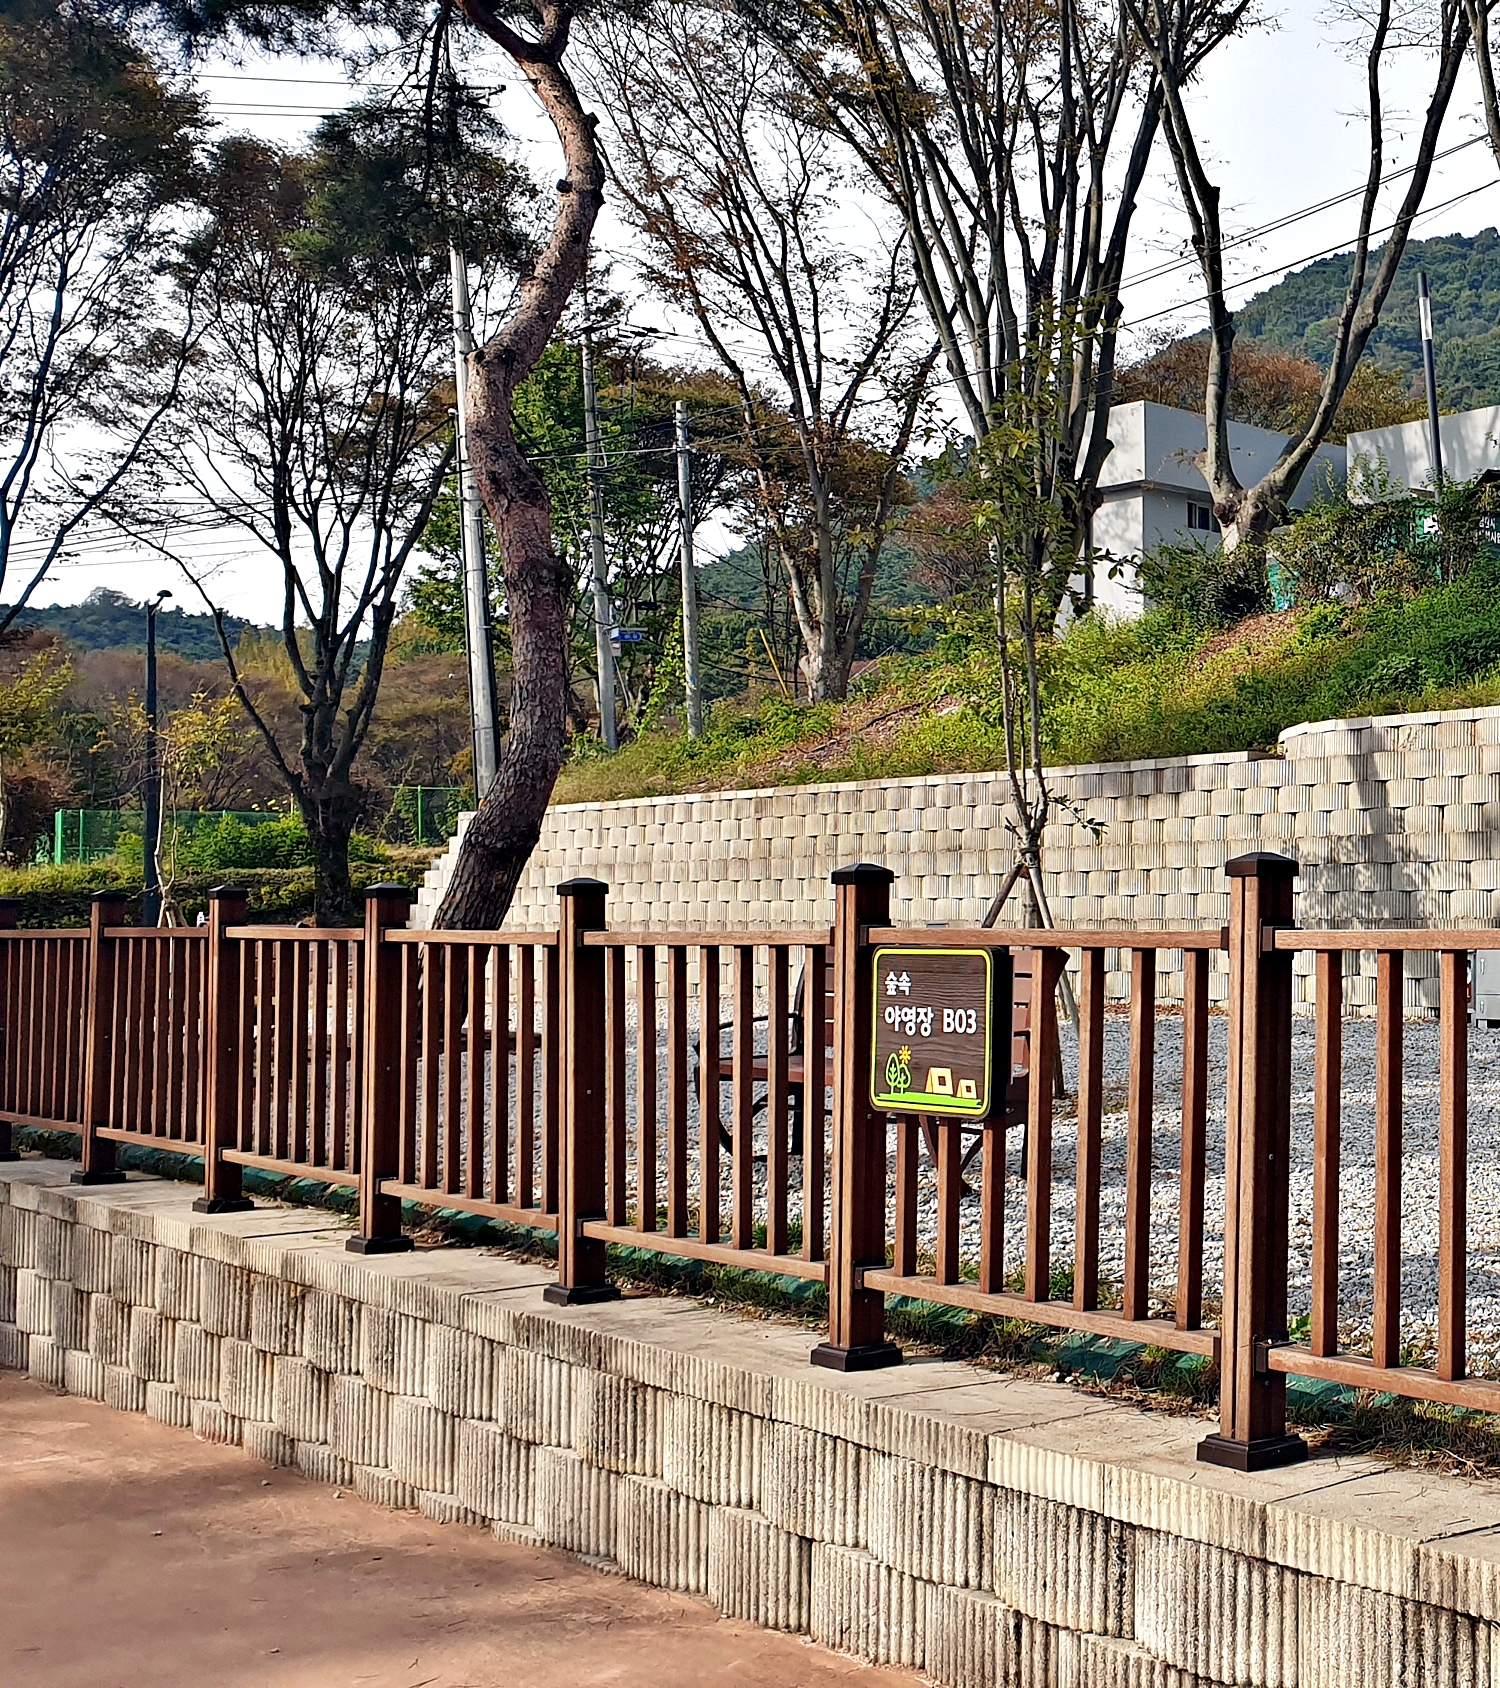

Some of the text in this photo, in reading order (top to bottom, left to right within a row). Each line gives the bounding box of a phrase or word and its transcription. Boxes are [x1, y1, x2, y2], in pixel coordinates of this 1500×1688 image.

[884, 971, 912, 996] 숲속
[884, 1005, 977, 1037] 야영장 B03
